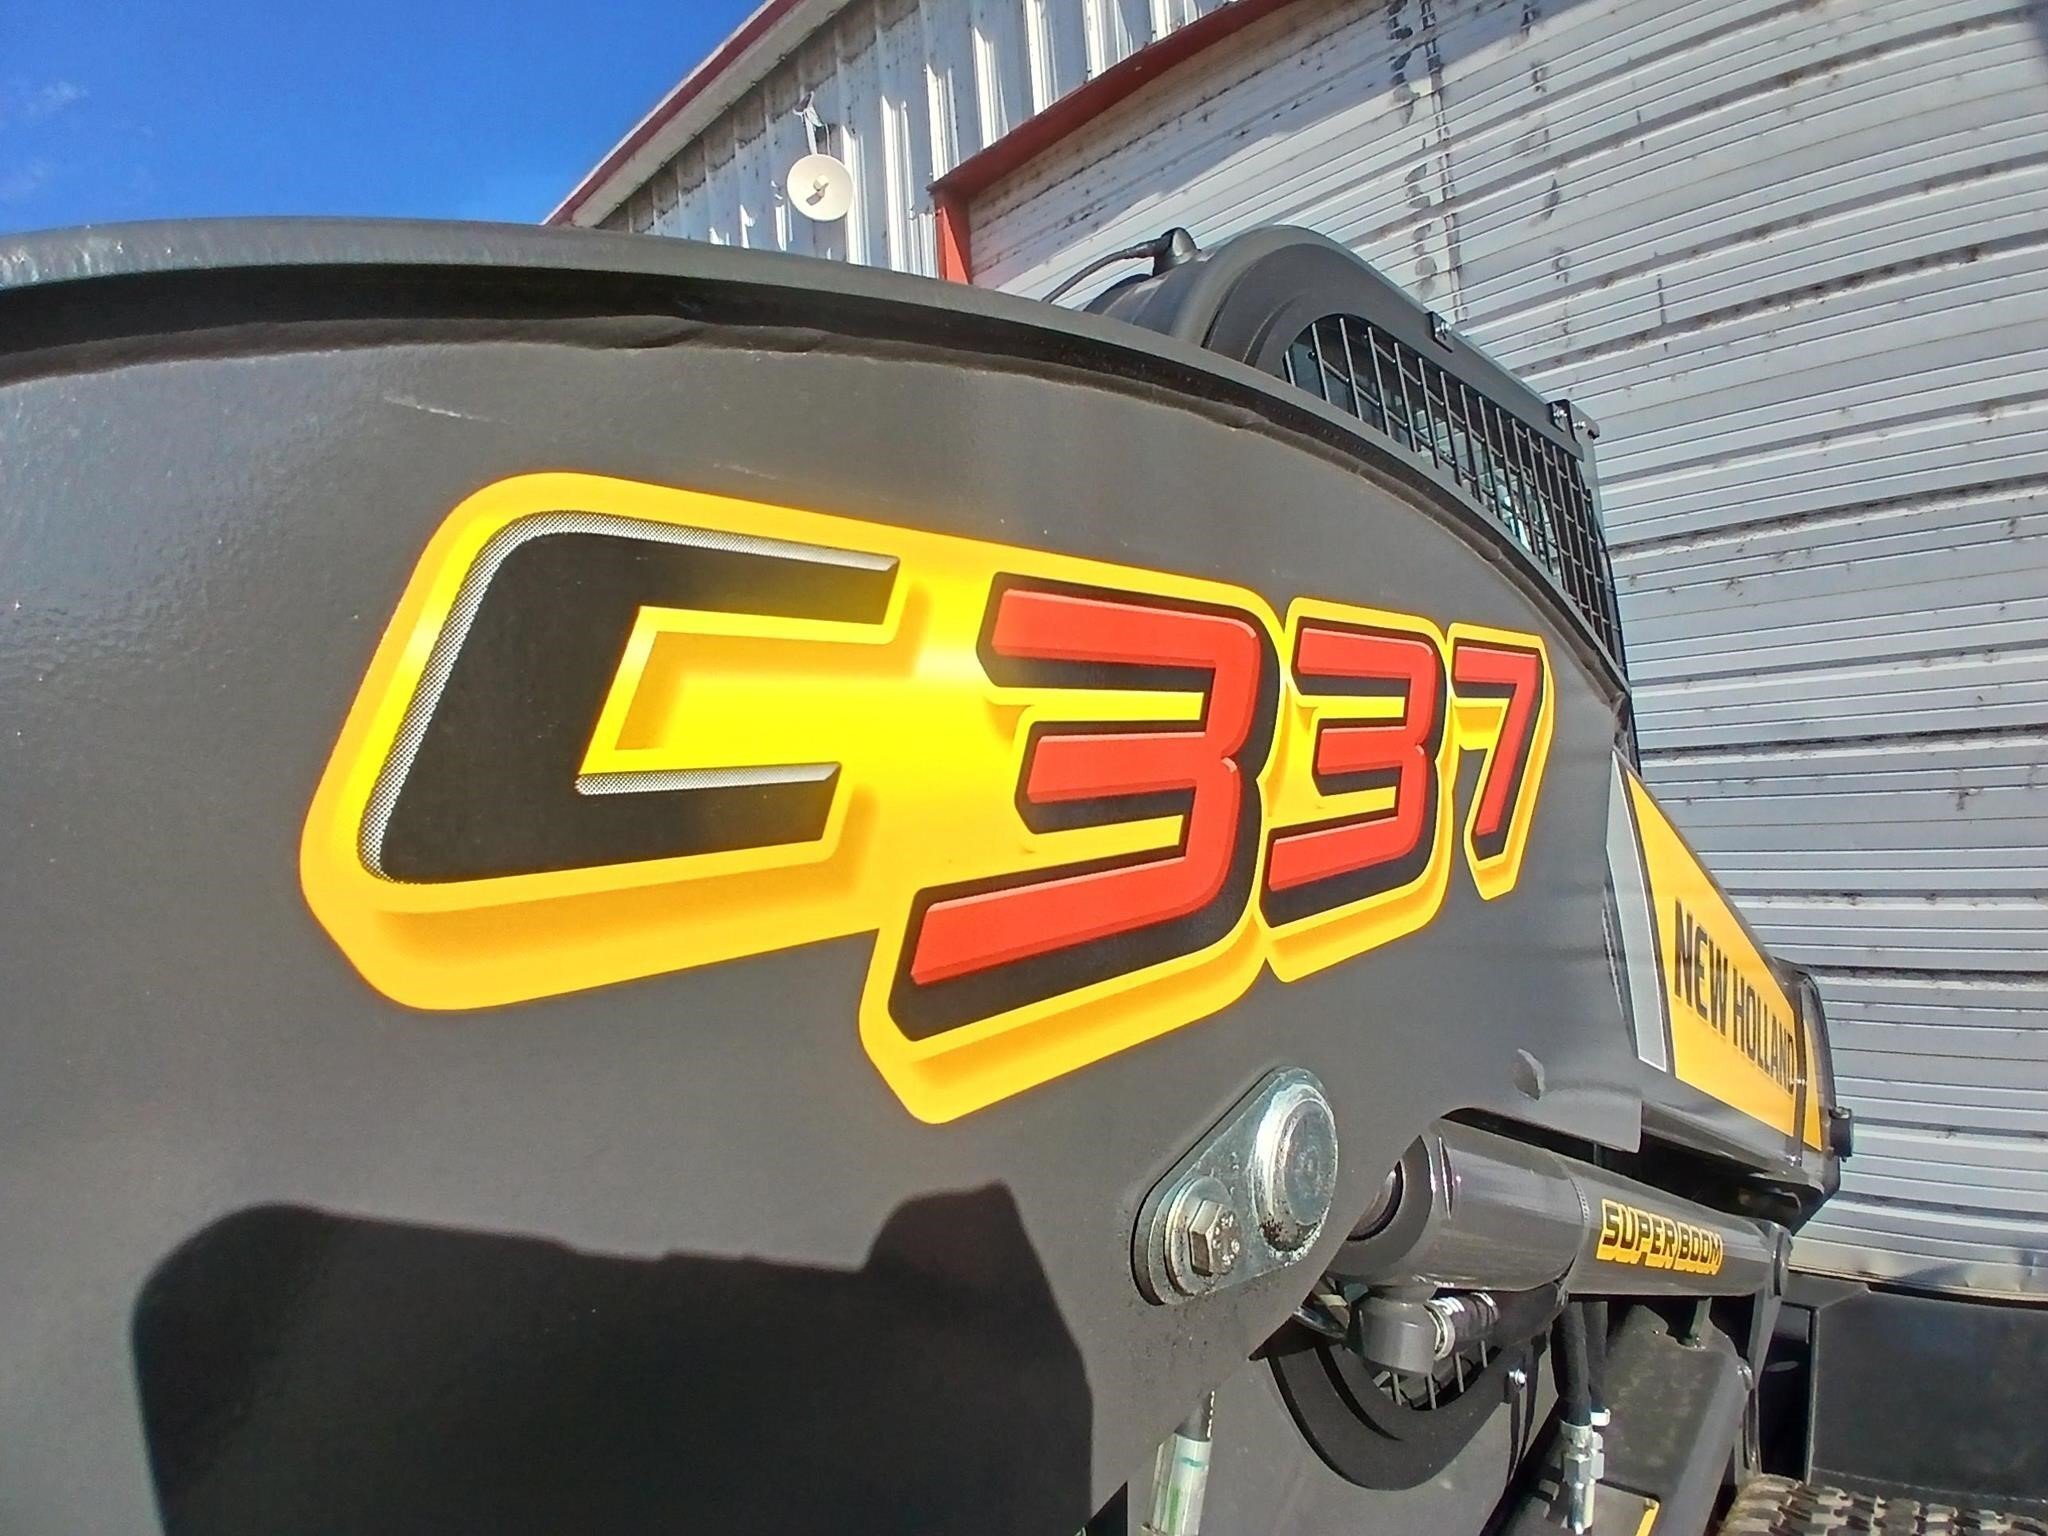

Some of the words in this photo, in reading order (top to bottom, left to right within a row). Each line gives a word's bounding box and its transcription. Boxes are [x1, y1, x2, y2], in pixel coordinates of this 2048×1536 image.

[348, 502, 1548, 1060] C337
[1675, 898, 1729, 1037] NEW
[1732, 966, 1795, 1096] HOLLAND
